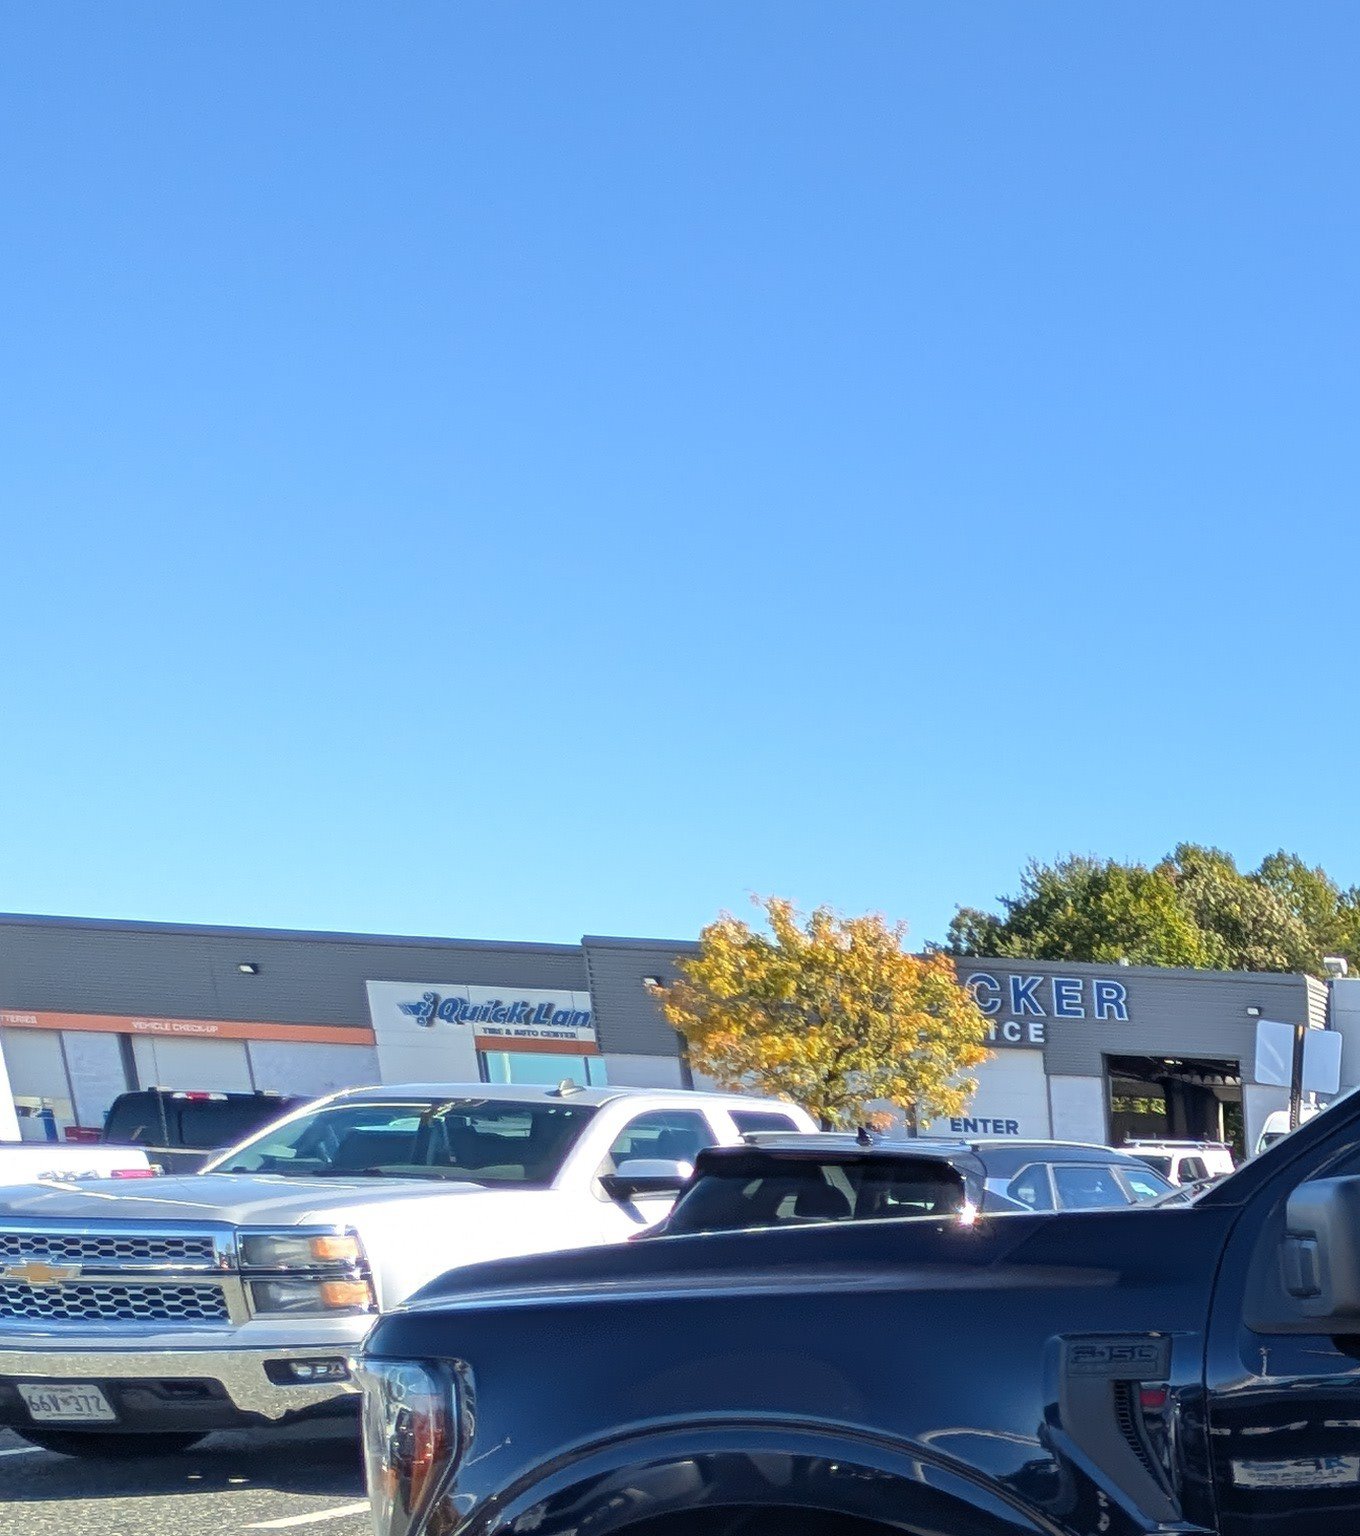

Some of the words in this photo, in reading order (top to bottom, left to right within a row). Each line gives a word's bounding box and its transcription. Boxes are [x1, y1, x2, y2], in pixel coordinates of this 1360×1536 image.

[964, 972, 1130, 1022] CKER
[437, 996, 528, 1025] Quick
[531, 1000, 592, 1027] Lan
[132, 1021, 171, 1031] VEHICLE
[482, 1027, 504, 1036] TIRE
[514, 1029, 539, 1037] AUTO
[540, 1030, 577, 1039] CENTER
[986, 1021, 1046, 1043] ICE
[950, 1117, 1020, 1135] ENTER
